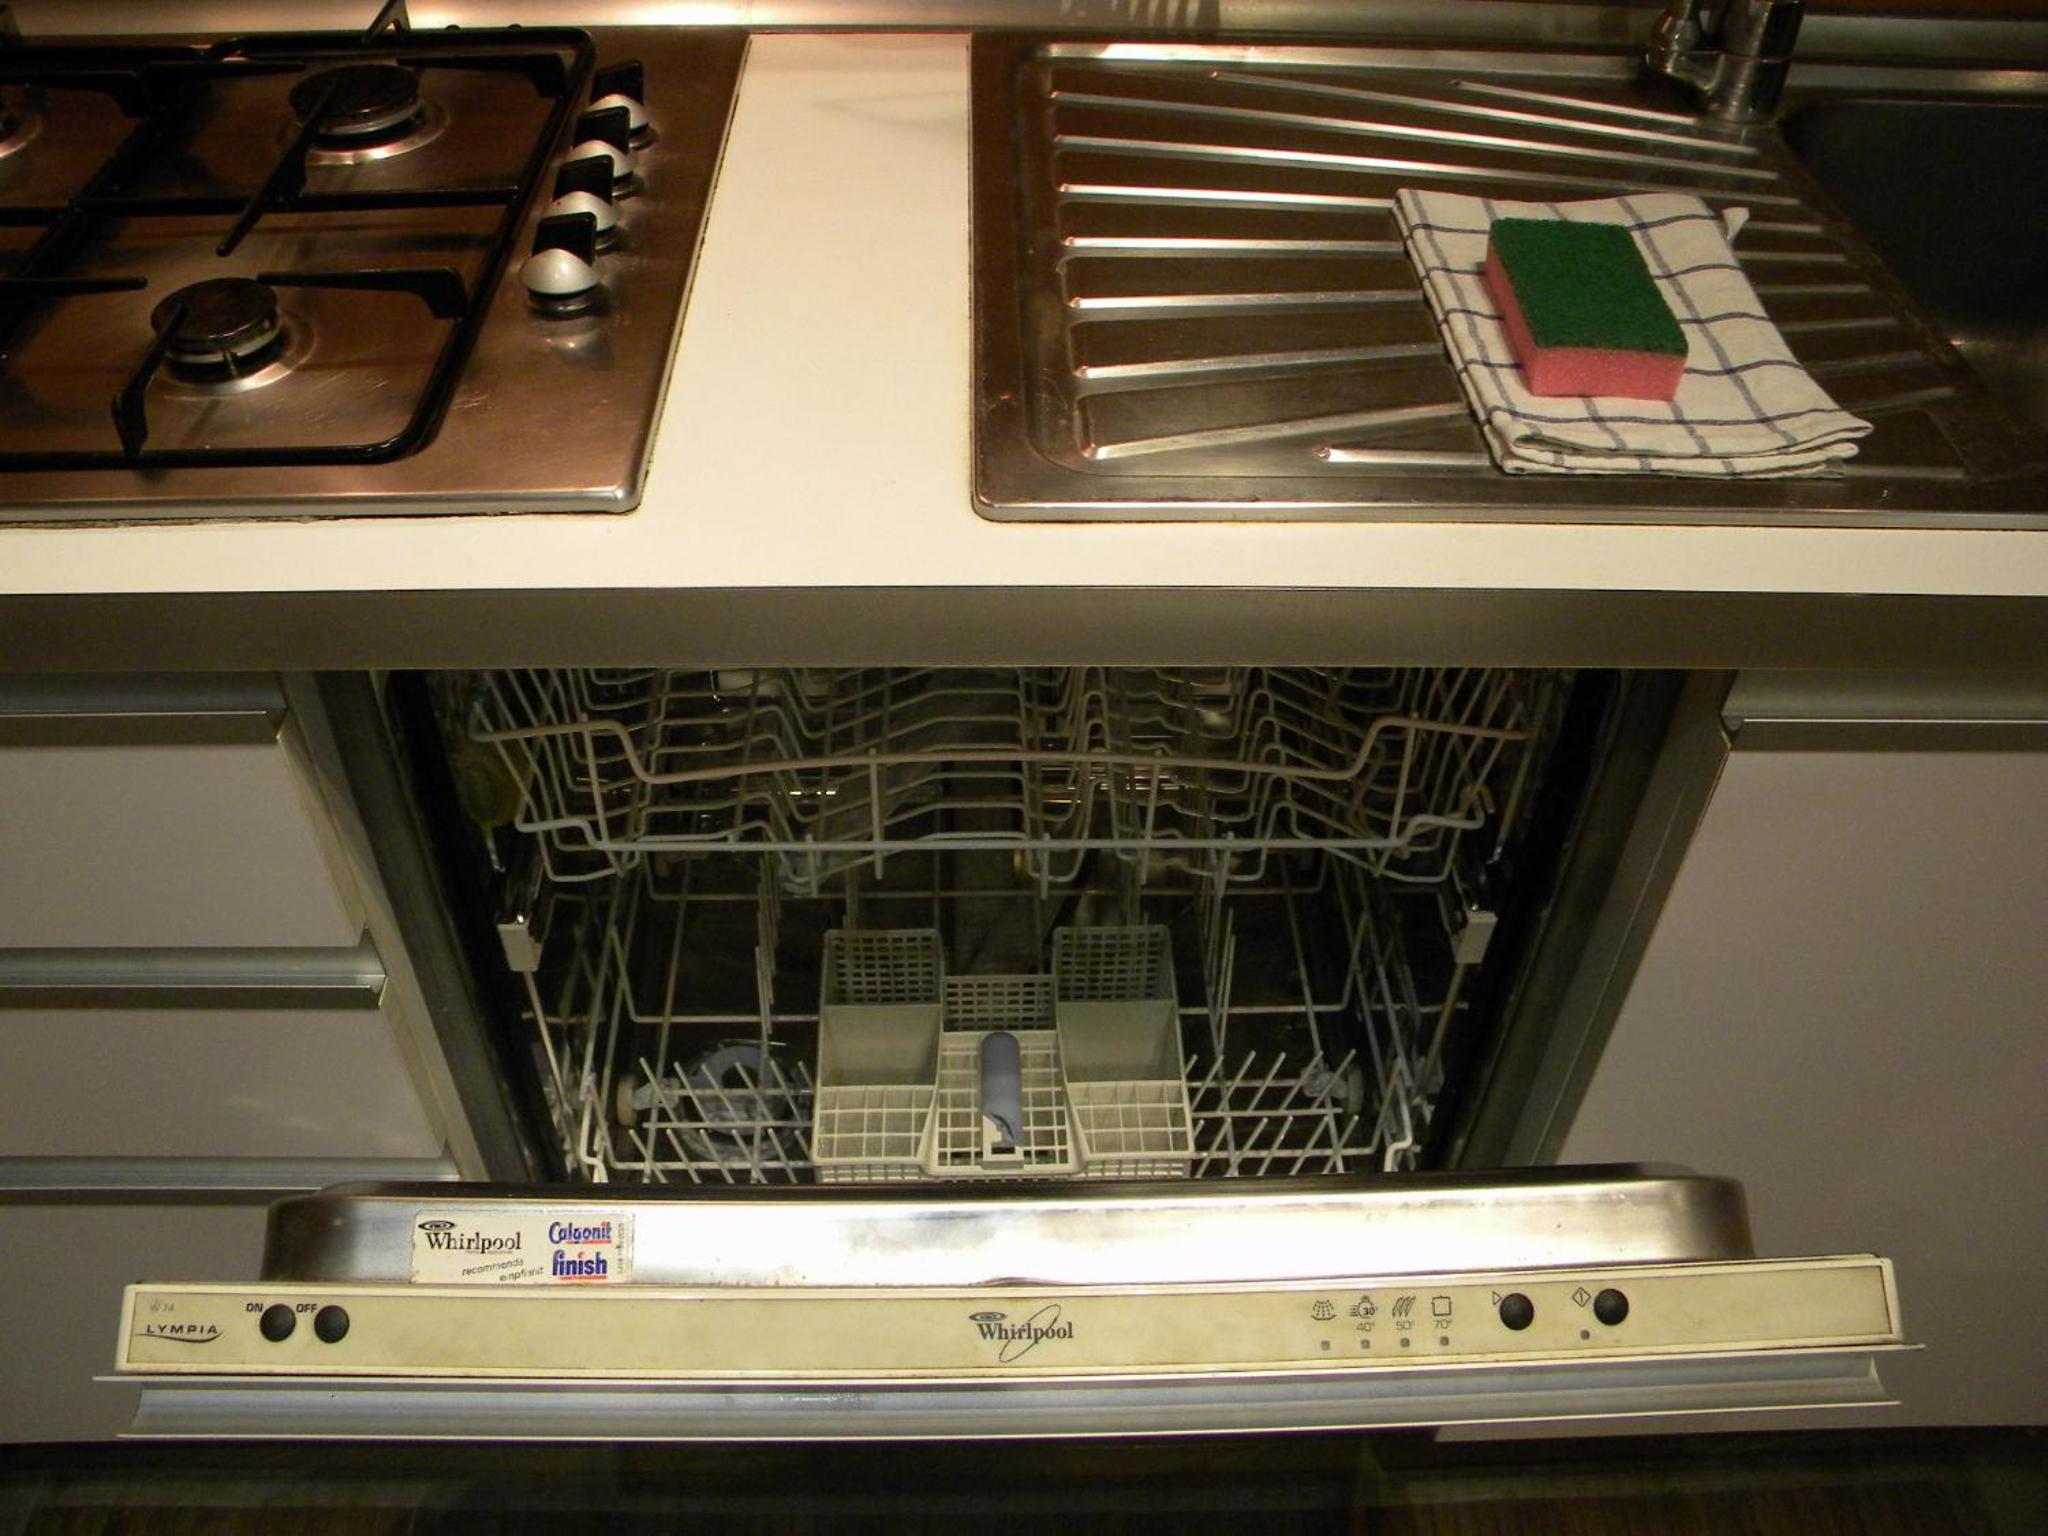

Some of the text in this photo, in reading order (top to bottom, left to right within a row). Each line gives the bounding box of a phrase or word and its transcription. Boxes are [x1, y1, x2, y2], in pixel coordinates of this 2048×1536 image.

[425, 1231, 522, 1254] Whirlpool
[548, 1221, 612, 1244] Calgonit
[552, 1249, 608, 1276] finish
[246, 1303, 318, 1313] ON OFF
[146, 1324, 219, 1334] LYMPIA
[976, 1321, 1074, 1344] Whirlpool
